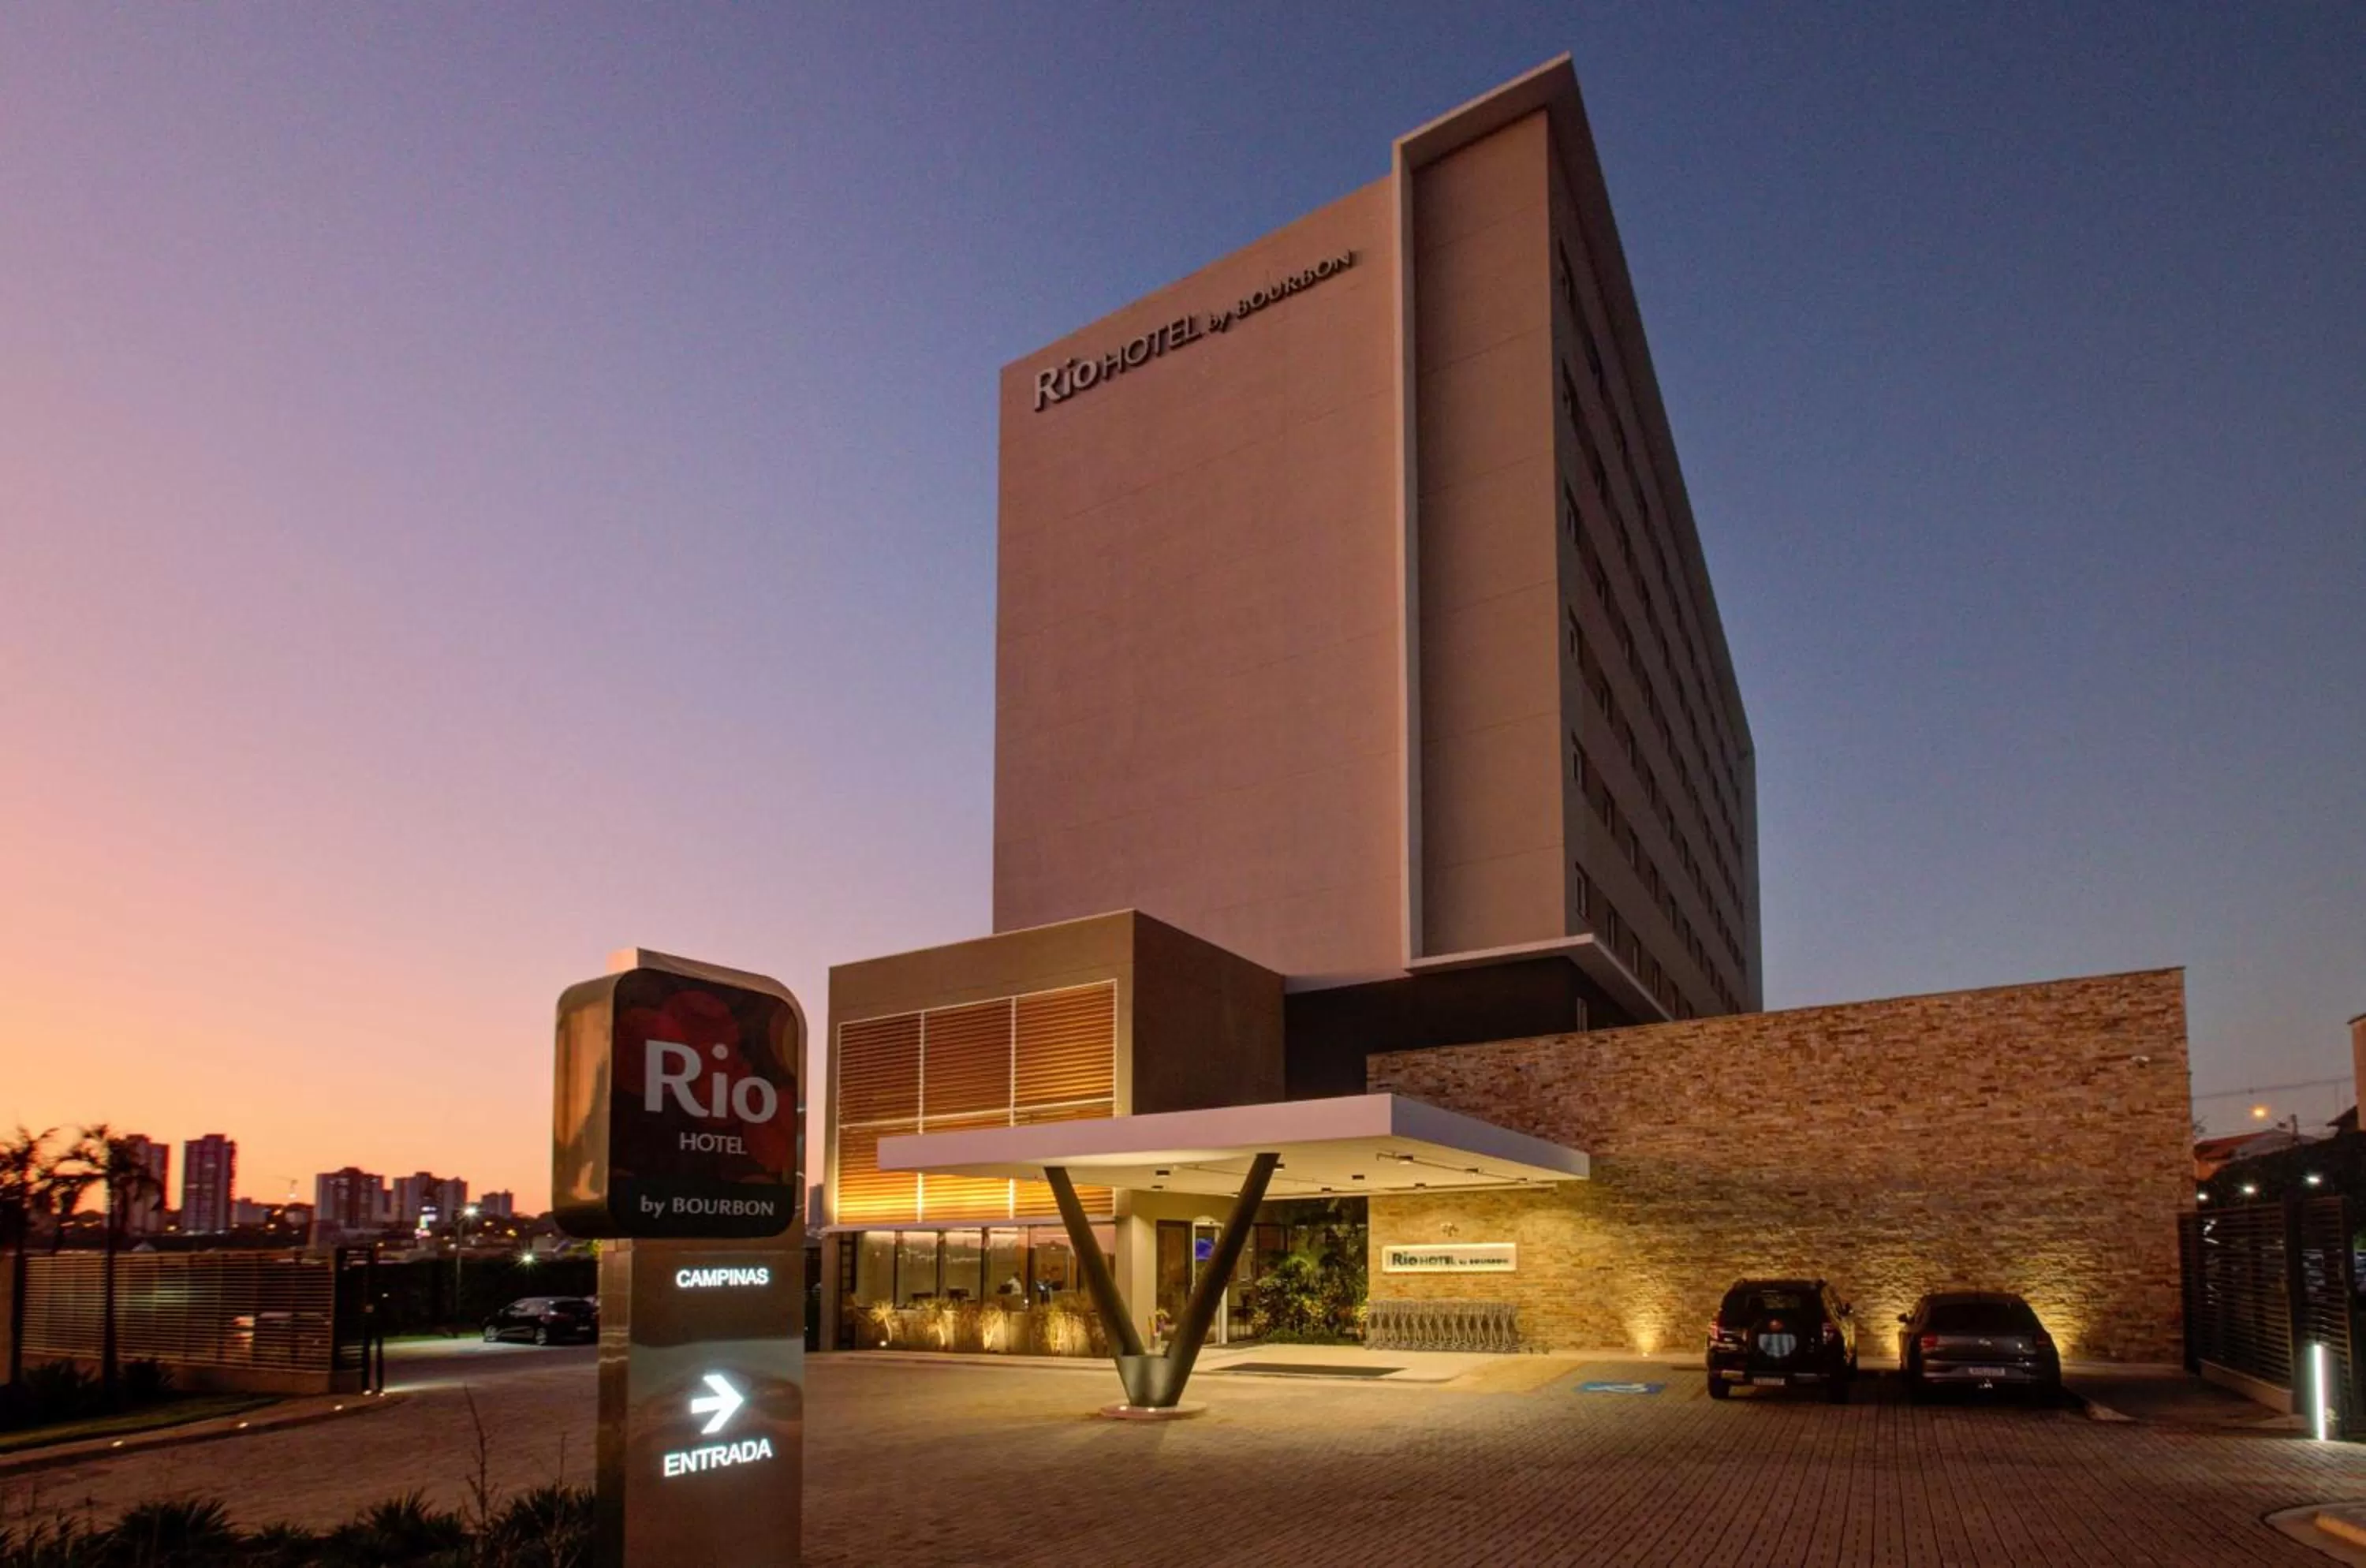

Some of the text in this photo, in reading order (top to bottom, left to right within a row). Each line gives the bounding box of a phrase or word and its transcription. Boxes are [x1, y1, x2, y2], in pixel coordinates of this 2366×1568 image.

[1034, 249, 1355, 413] Rio HOTEL by BOURBON
[644, 1039, 778, 1124] Rio
[679, 1131, 748, 1155] HOTEL
[640, 1195, 775, 1219] by BOURBON
[674, 1267, 771, 1288] CAMPINAS
[662, 1437, 774, 1478] ENTRADA
